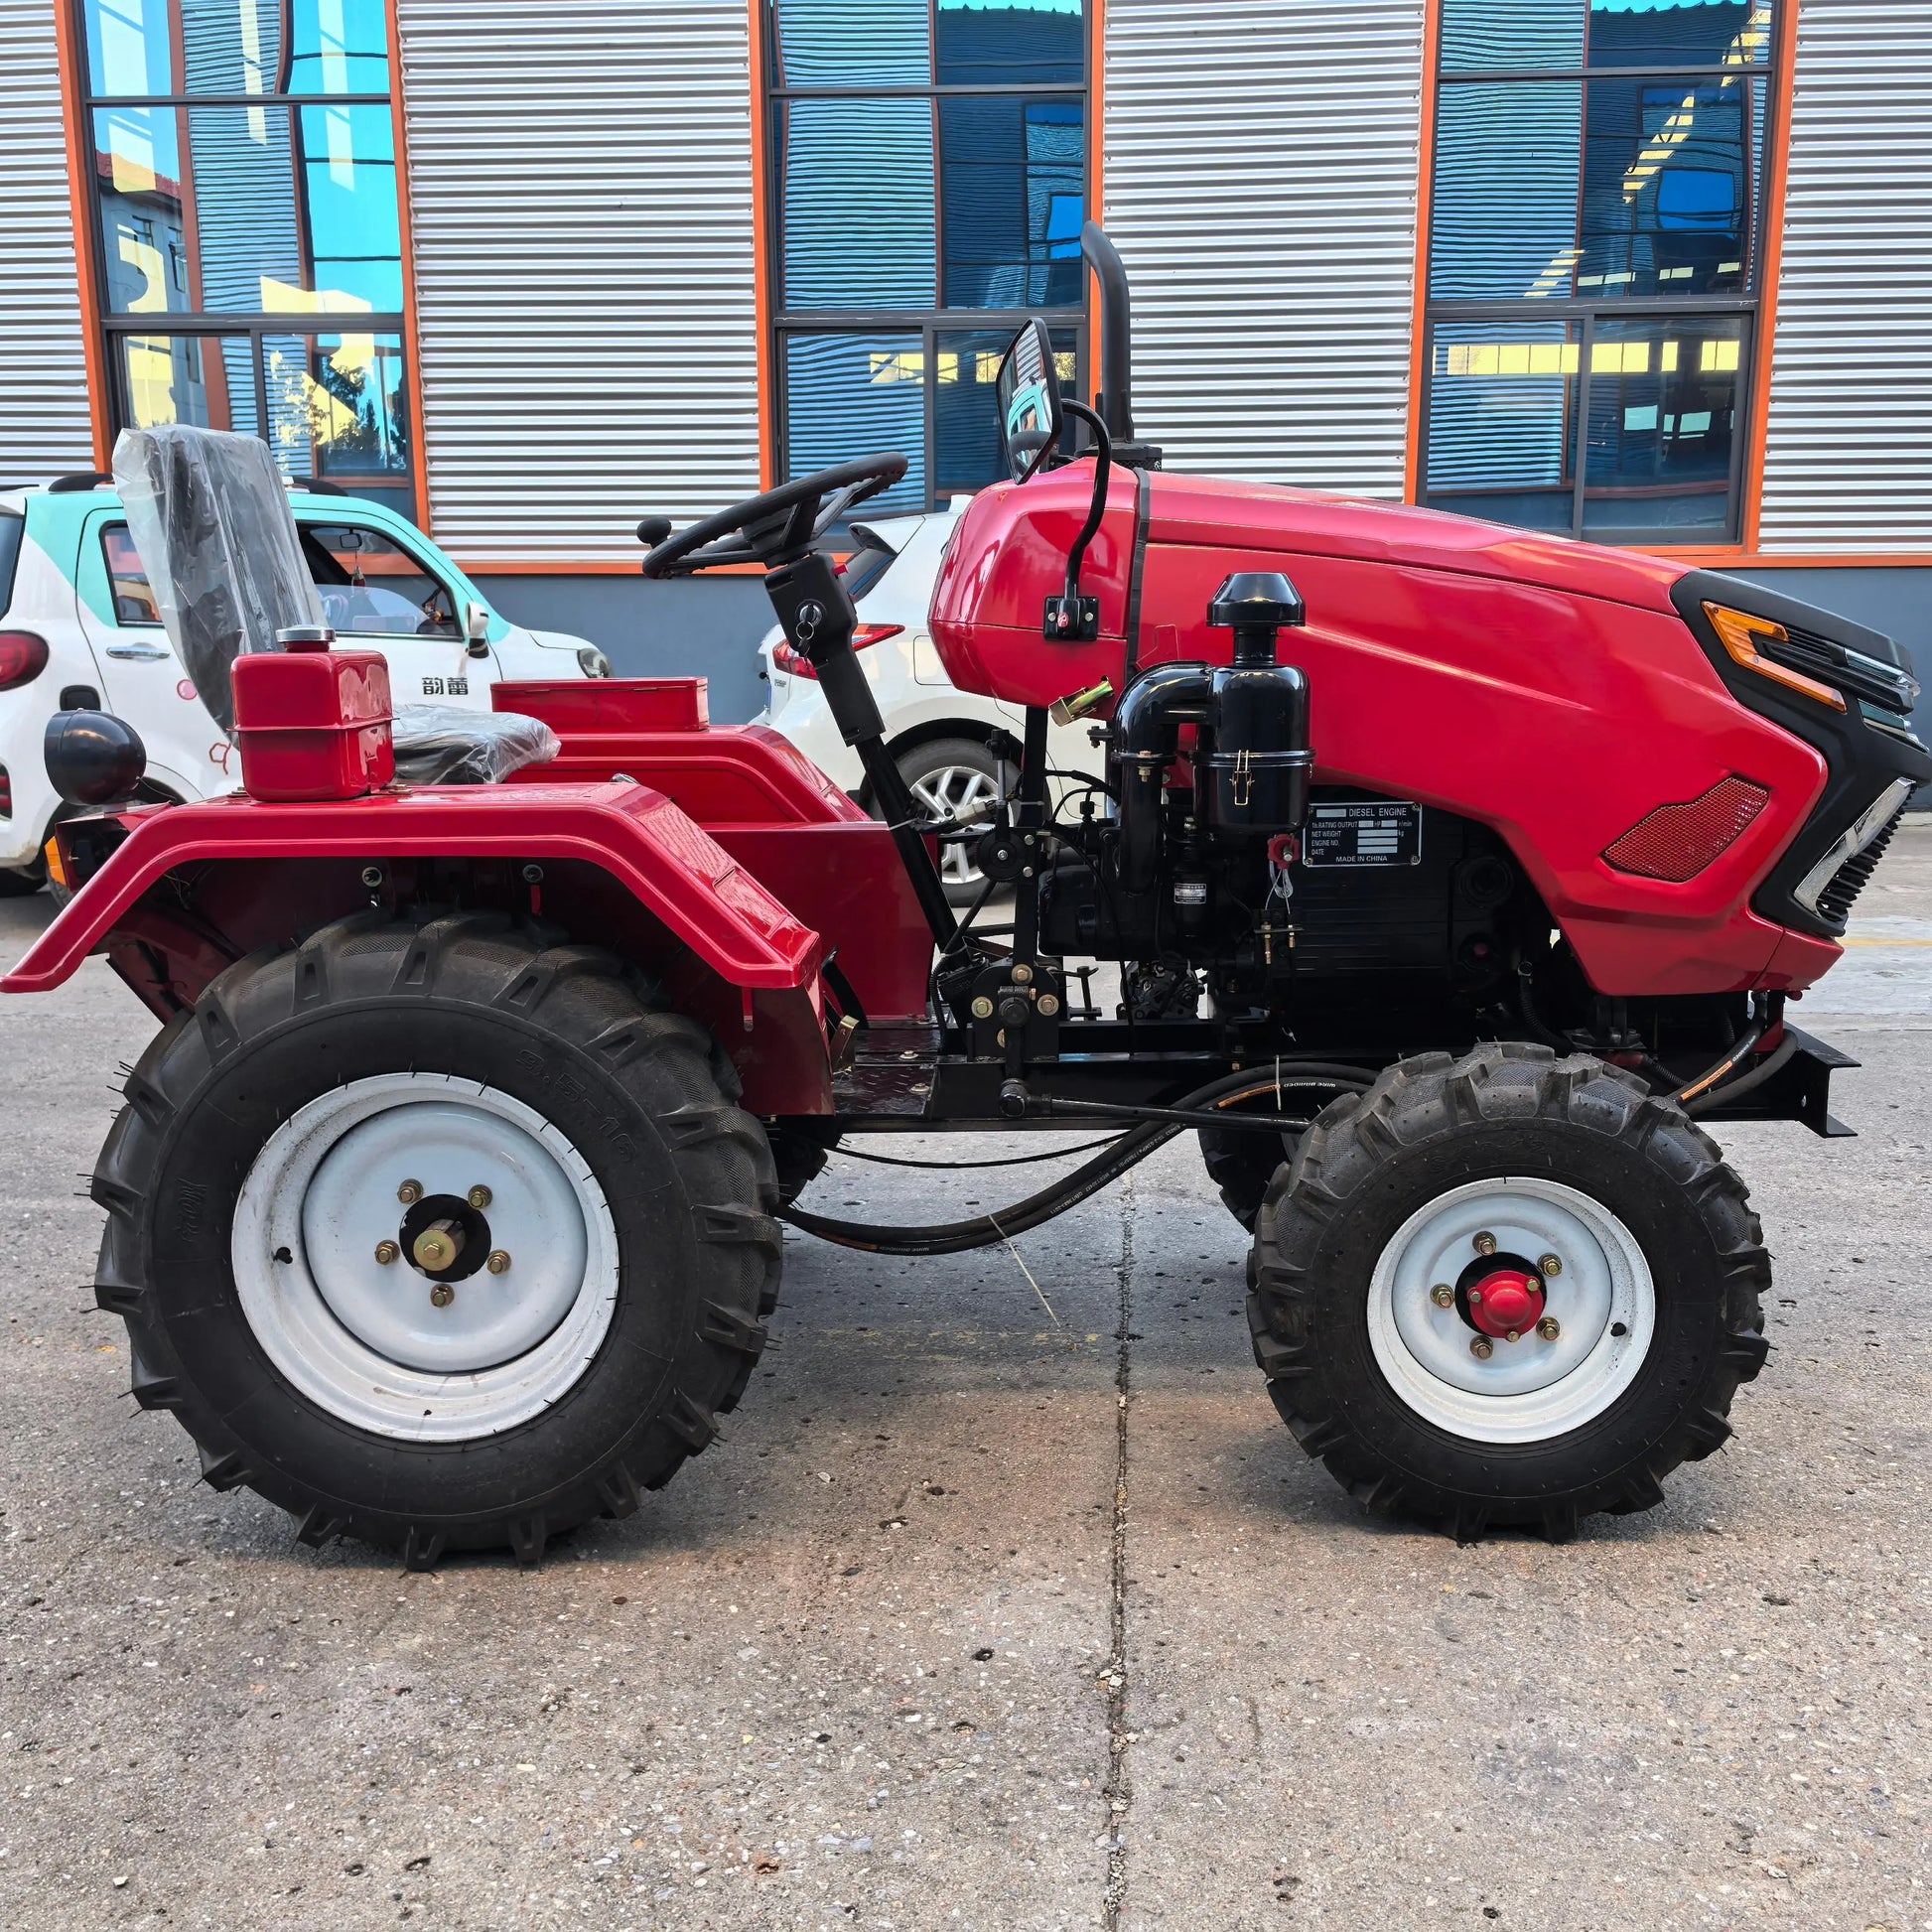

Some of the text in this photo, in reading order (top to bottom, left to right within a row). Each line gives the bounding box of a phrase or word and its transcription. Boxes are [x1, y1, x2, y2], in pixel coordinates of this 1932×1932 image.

[422, 676, 469, 695] 韵蕾
[1349, 807, 1407, 817] DIESEL ENGINE
